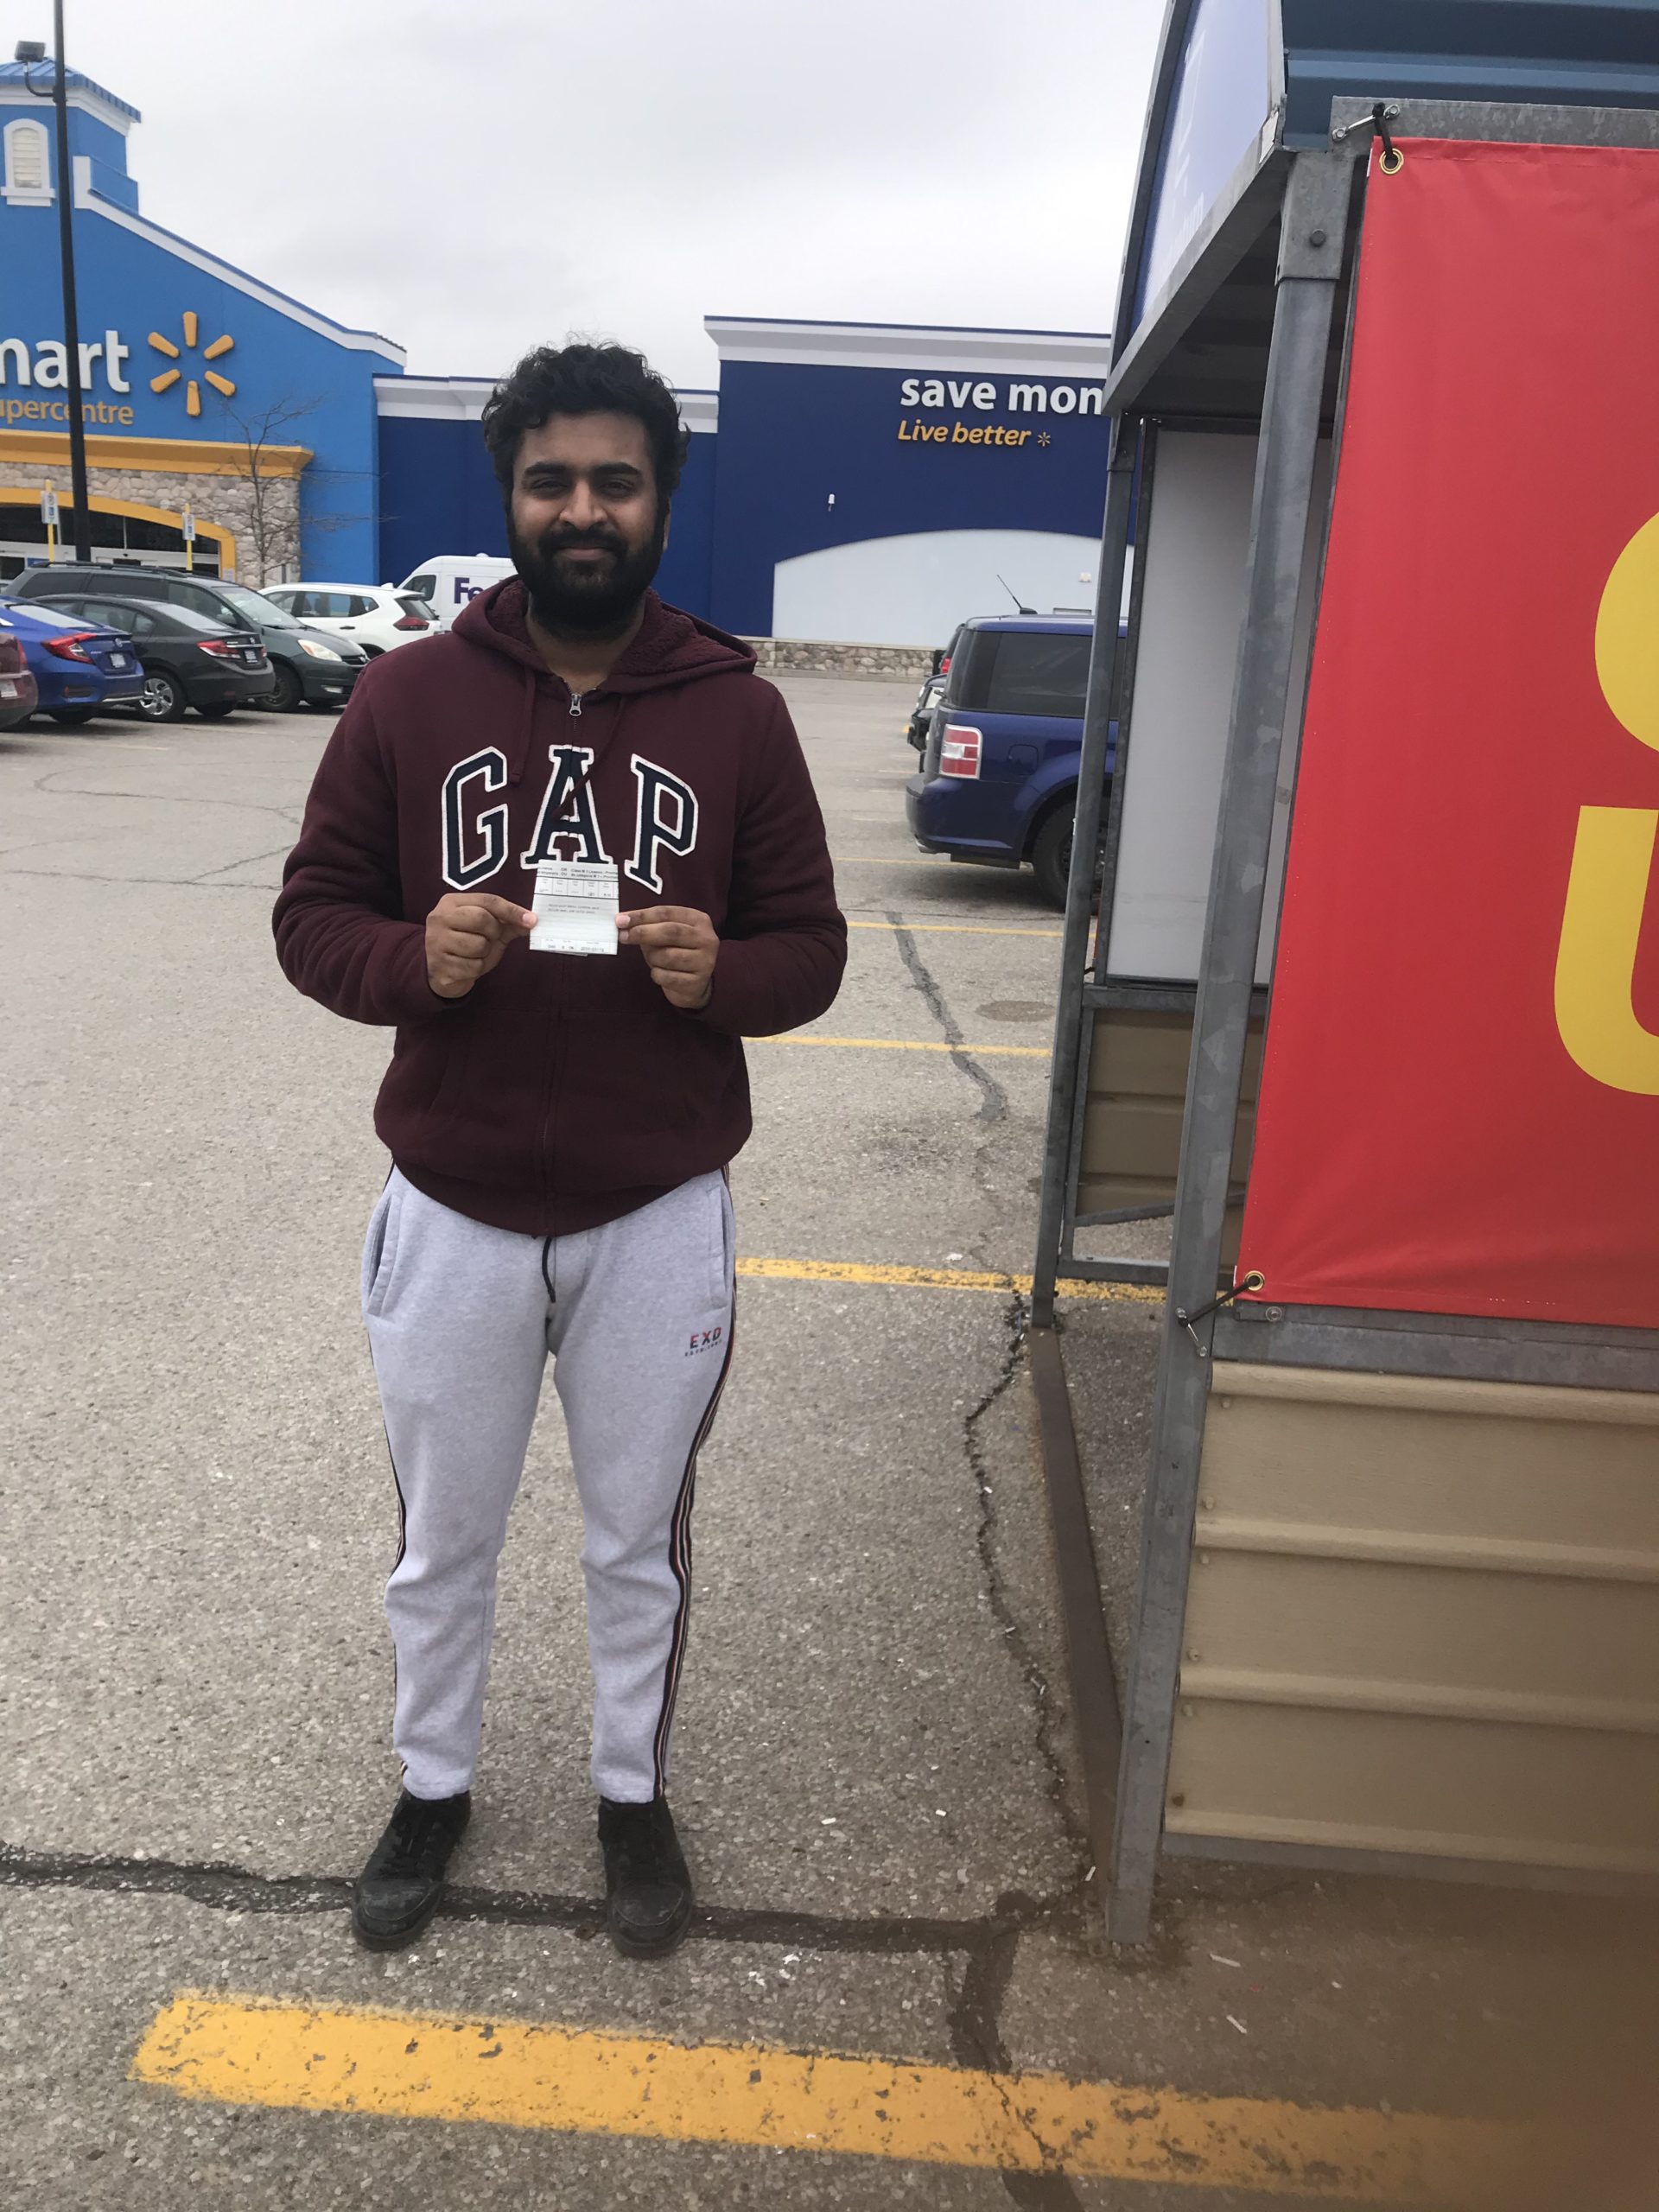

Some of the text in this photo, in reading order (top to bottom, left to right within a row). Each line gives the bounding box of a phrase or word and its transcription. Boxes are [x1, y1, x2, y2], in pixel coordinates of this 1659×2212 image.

[900, 378, 996, 410] save
[897, 419, 1032, 447] Live better
[441, 744, 698, 895] GAP
